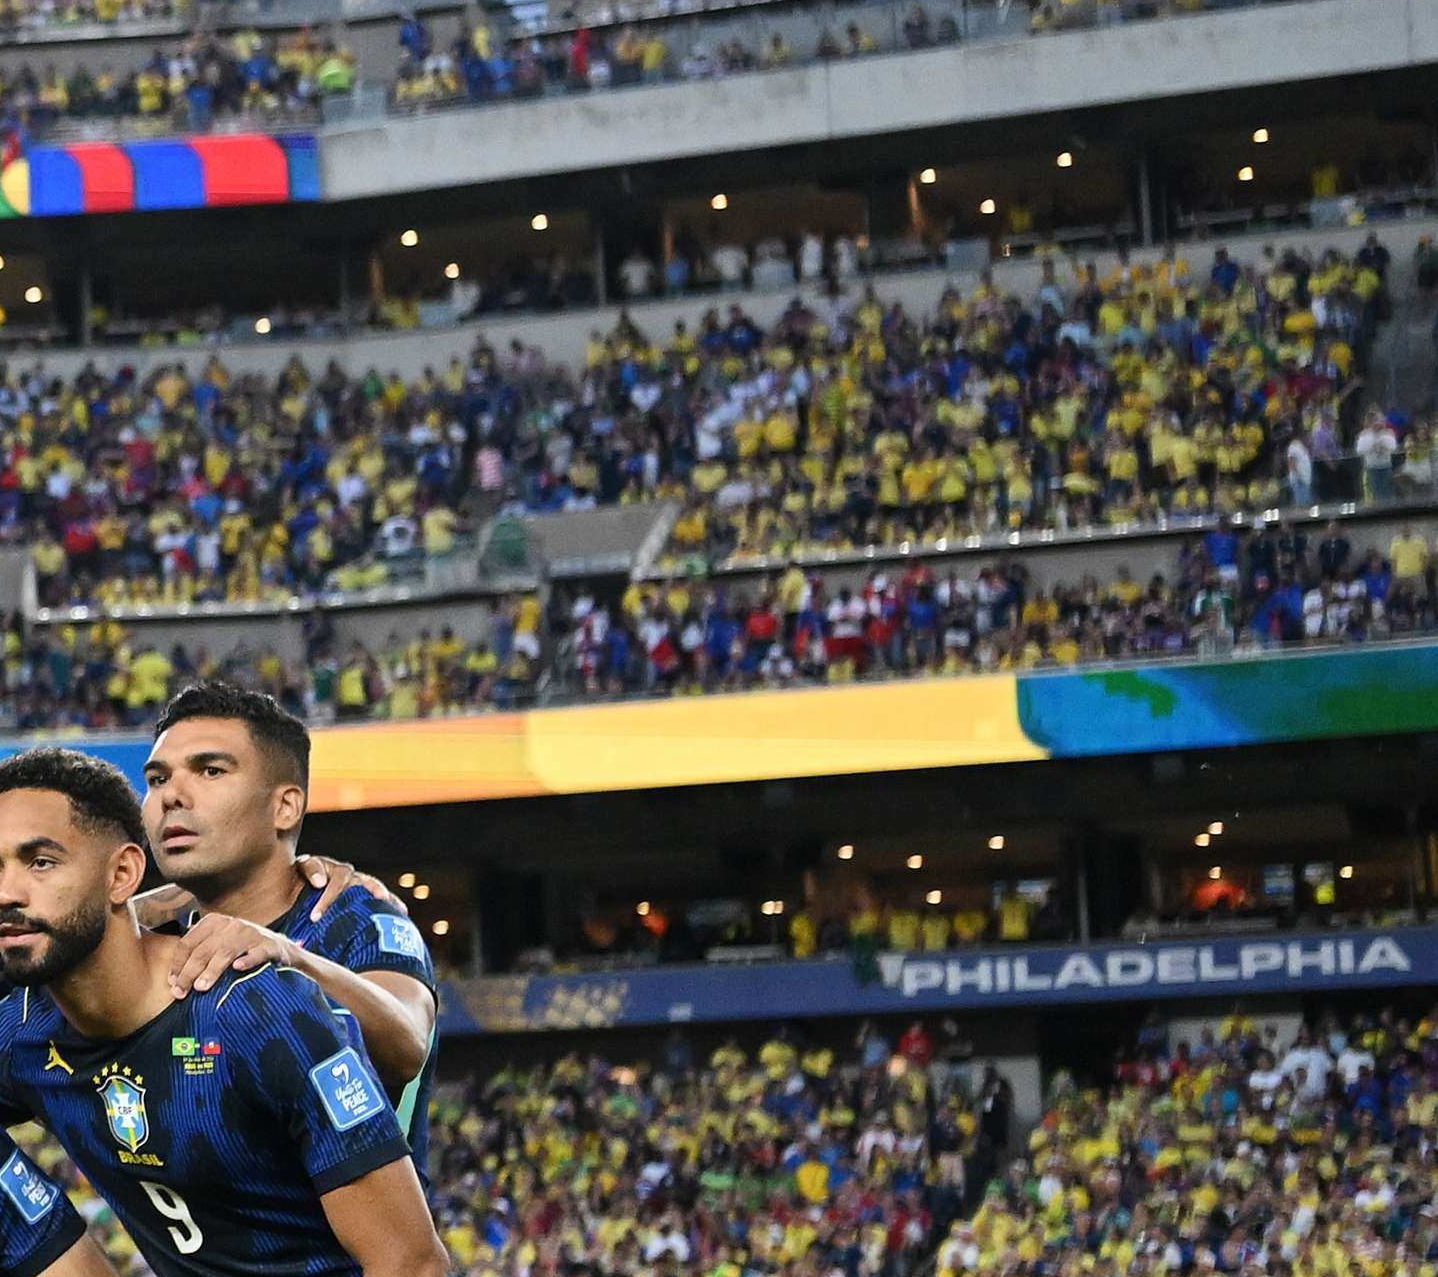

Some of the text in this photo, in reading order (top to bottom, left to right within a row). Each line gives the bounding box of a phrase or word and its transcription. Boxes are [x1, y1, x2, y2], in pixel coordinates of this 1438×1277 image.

[900, 936, 1411, 997] PHILADELPHIA
[118, 1150, 164, 1166] BRASIL
[140, 1180, 203, 1255] 9
